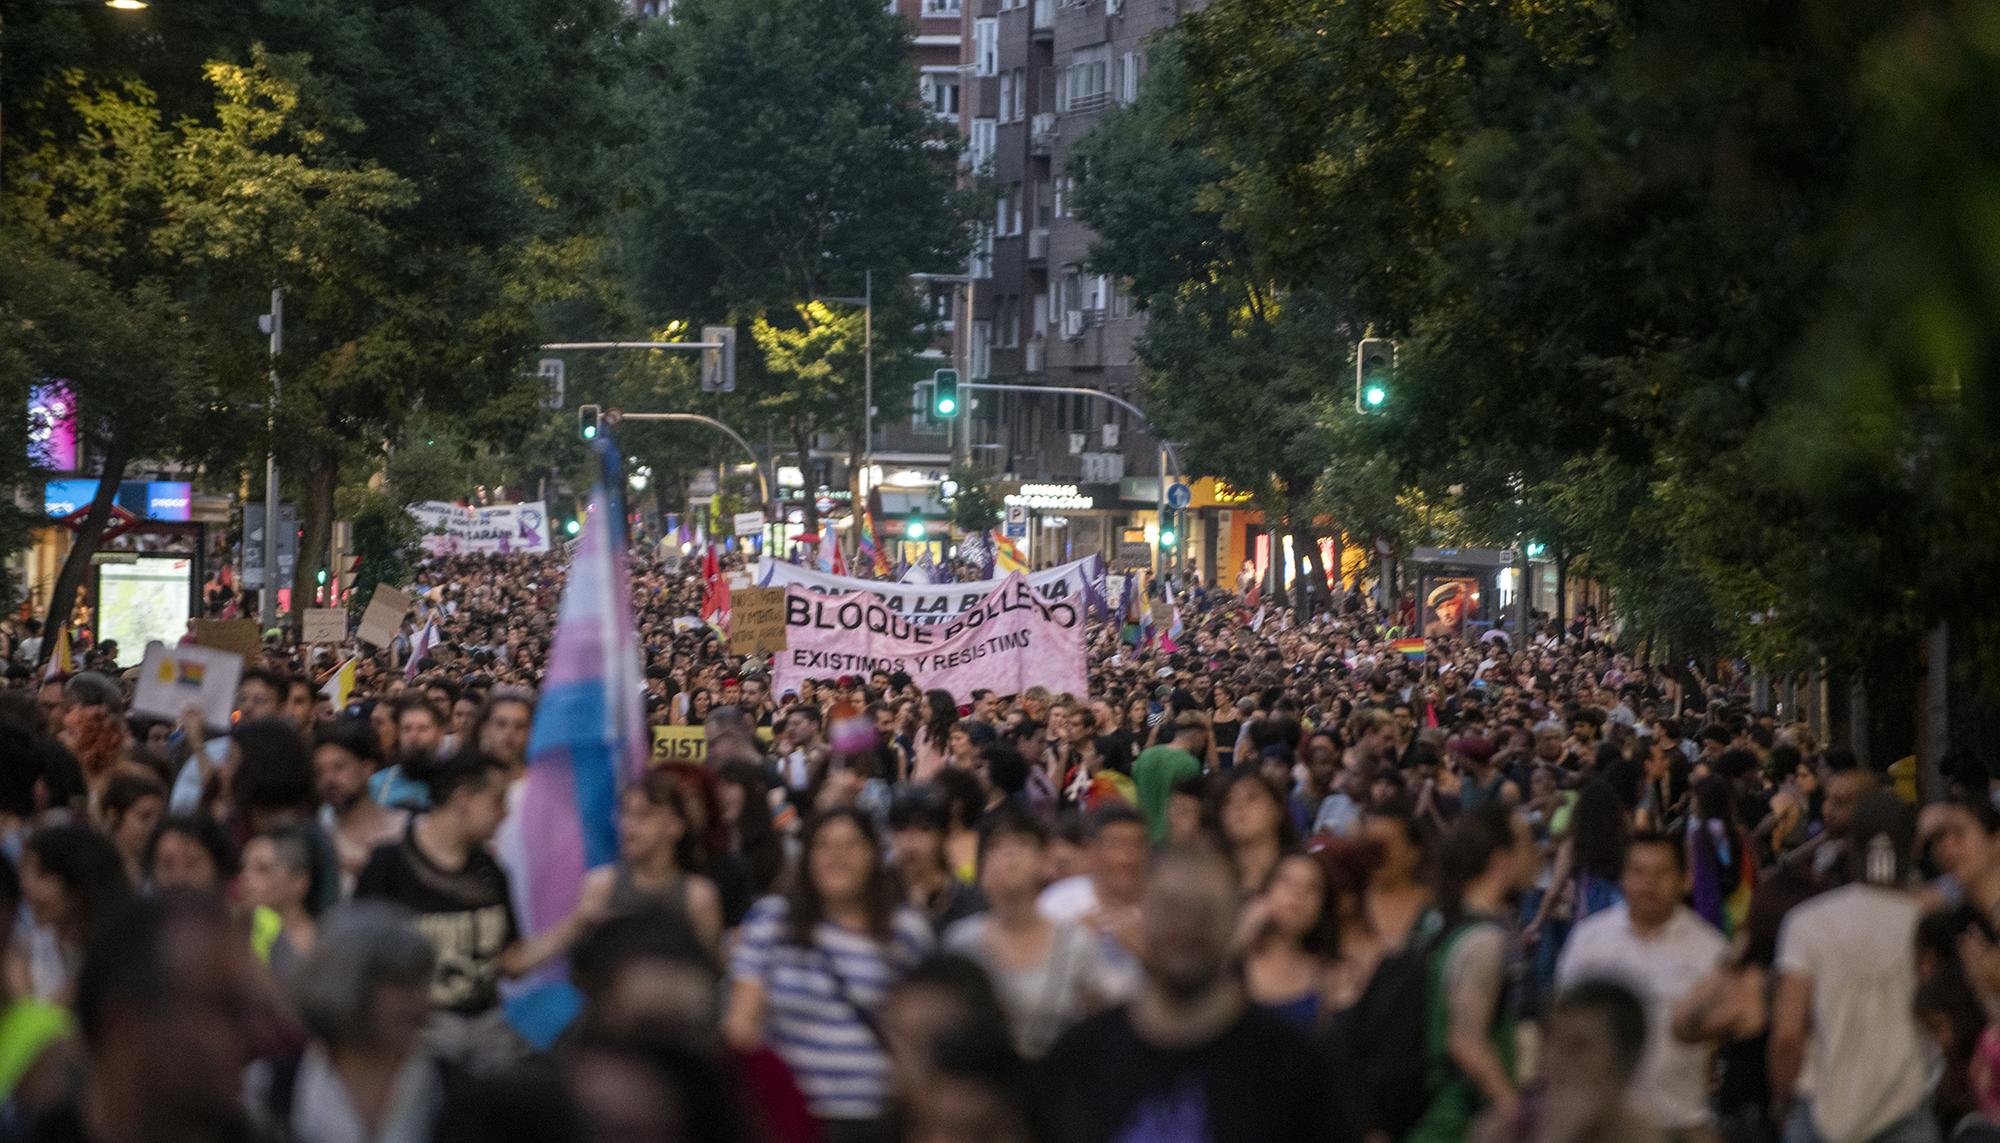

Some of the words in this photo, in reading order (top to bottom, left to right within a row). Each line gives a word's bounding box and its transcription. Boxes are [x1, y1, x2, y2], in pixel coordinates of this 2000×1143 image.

[786, 594, 933, 645] BLOQUE
[793, 649, 905, 673] EXISTIMOS
[913, 655, 928, 673] Y
